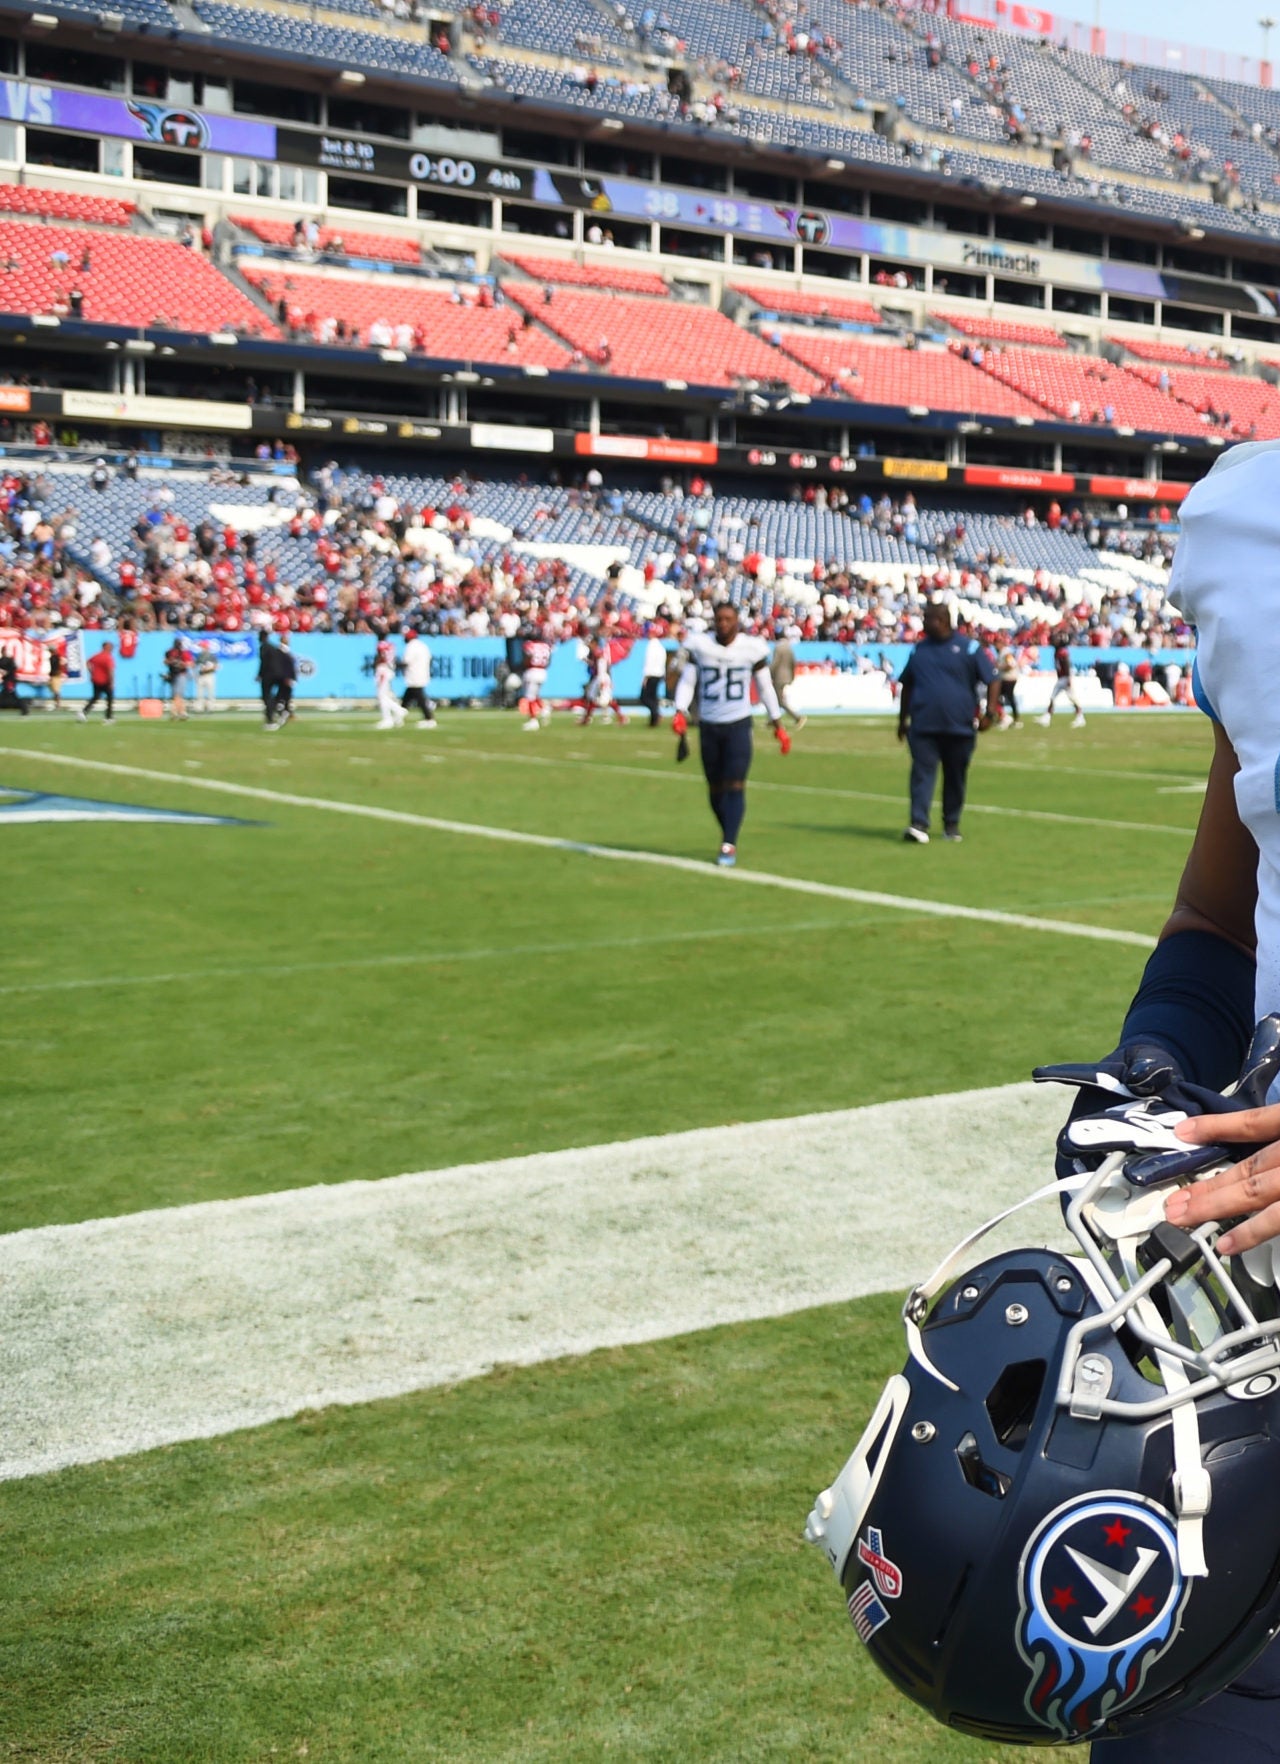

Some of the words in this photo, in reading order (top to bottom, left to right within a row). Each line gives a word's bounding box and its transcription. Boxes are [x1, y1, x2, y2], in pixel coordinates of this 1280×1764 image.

[6, 80, 52, 125] VS
[409, 153, 476, 186] 0:00
[487, 168, 521, 190] 4th
[964, 243, 1040, 273] Pinnacle
[702, 666, 745, 701] 26
